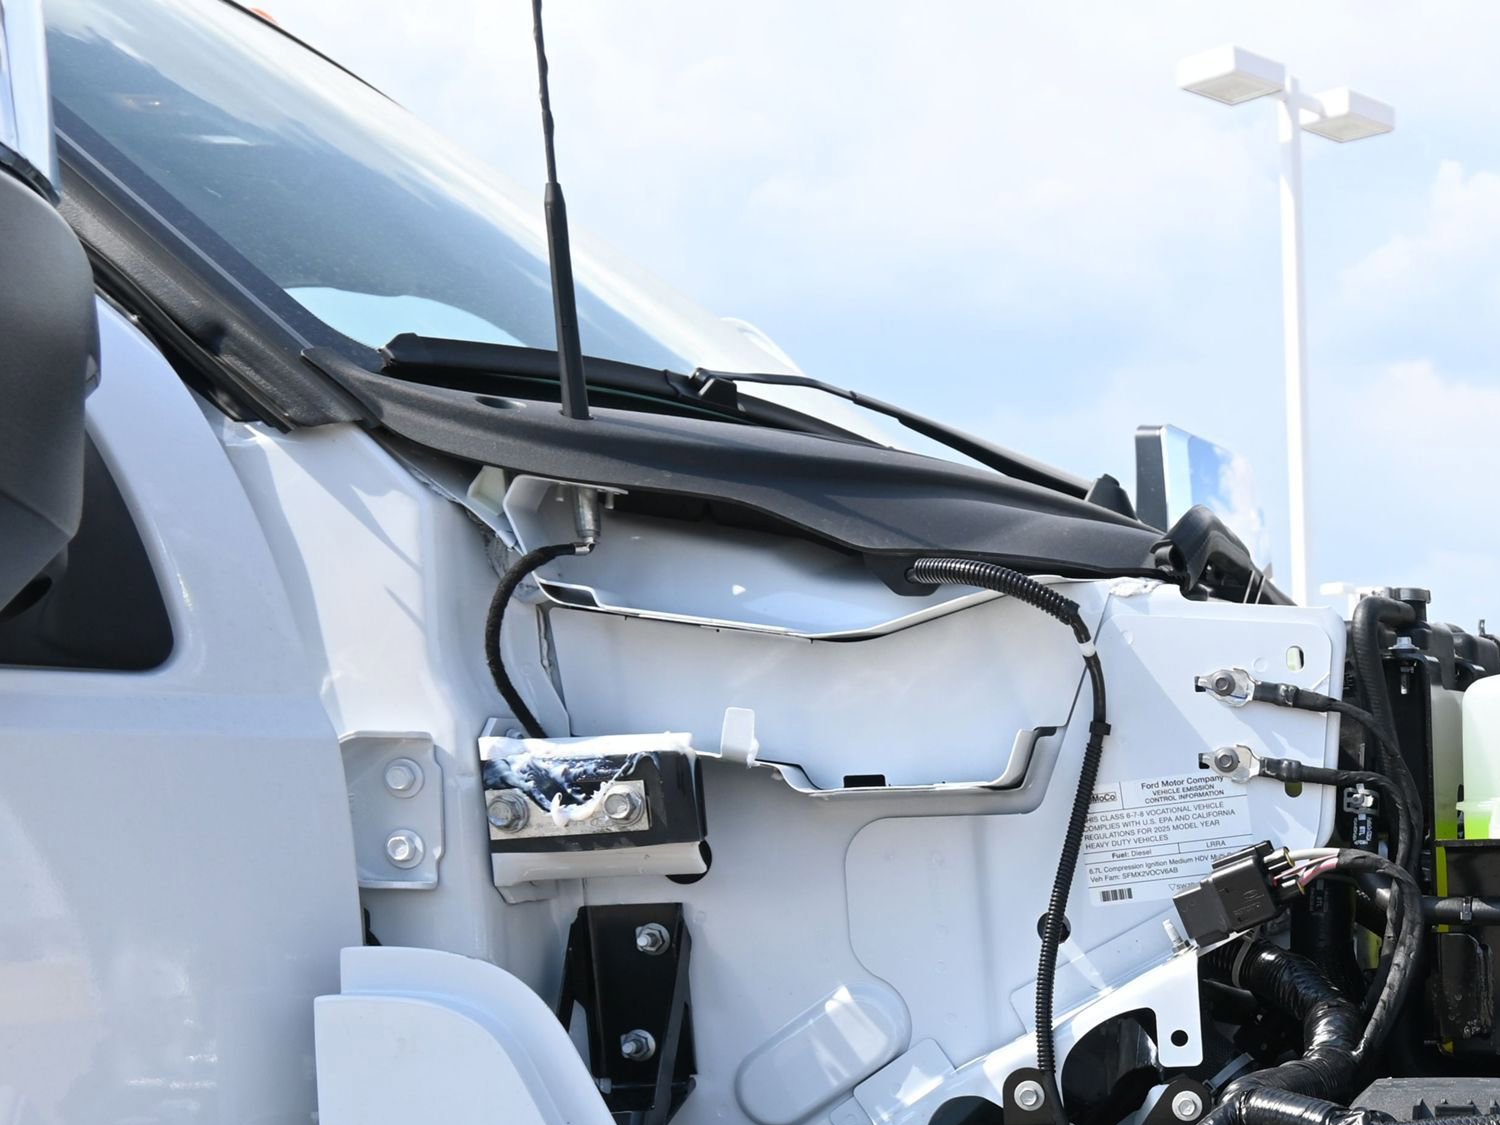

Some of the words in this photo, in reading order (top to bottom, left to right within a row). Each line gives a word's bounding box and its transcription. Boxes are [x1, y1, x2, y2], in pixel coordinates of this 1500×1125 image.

[1162, 779, 1185, 787] Motor
[1187, 775, 1224, 785] Company
[1153, 788, 1180, 796] VEHICLE
[1182, 784, 1215, 792] EMISSION
[1145, 795, 1177, 804] CONTROL
[1179, 790, 1224, 800] INFORMATION
[1146, 805, 1191, 816] VOCATIONAL
[1193, 802, 1224, 811] VEHICLE
[1192, 809, 1236, 820] CALIFORNIA
[1085, 829, 1135, 841] REGULATIONS
[1173, 822, 1198, 831] MODEL
[1134, 834, 1169, 844] VEHICLES
[1206, 840, 1226, 848] LRRA
[1104, 863, 1144, 873] Compression
[1146, 860, 1168, 868] Ignition
[1169, 857, 1193, 865] Medium
